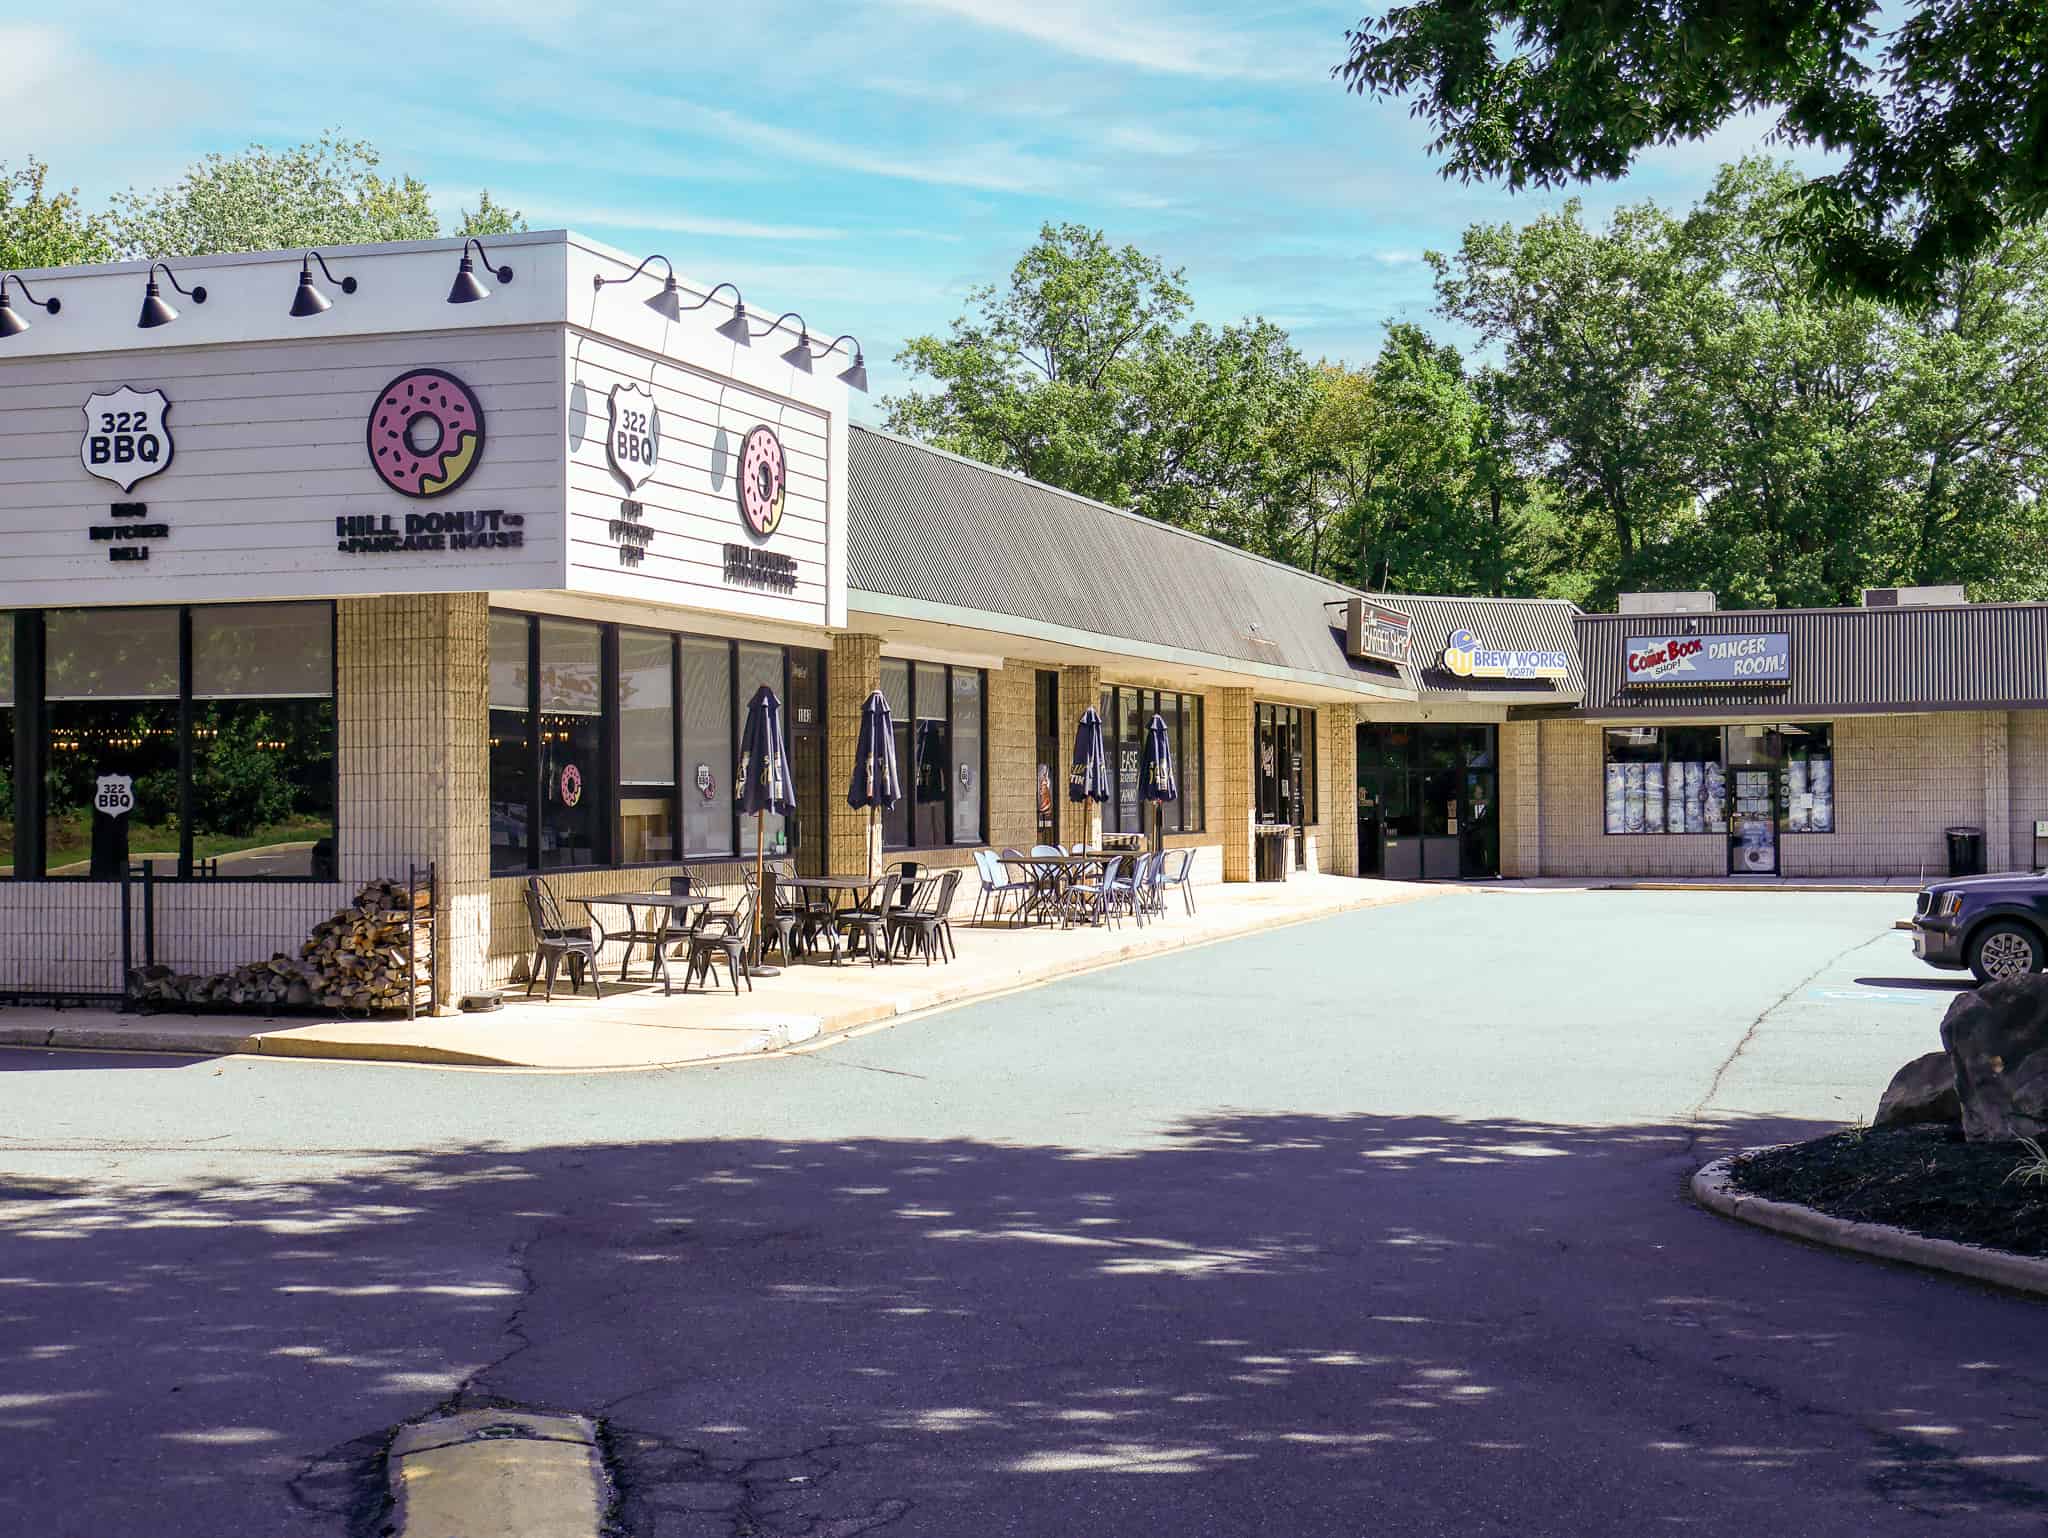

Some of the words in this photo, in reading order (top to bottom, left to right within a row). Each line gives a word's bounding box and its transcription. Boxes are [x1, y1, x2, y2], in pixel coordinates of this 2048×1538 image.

[101, 411, 147, 433] 322
[623, 409, 646, 433] 322
[90, 434, 160, 464] BBQ
[618, 431, 652, 466] BBQ
[336, 515, 399, 536] HILL
[405, 510, 504, 534] DONUT
[1709, 638, 1766, 659] DANGER
[1474, 651, 1512, 667] BREW
[1515, 651, 1567, 668] WORKS
[1655, 659, 1681, 675] SHOP!
[1734, 653, 1787, 676] ROOM!
[1506, 667, 1536, 677] NORTH
[103, 783, 125, 794] 322
[99, 794, 130, 808] BBQ
